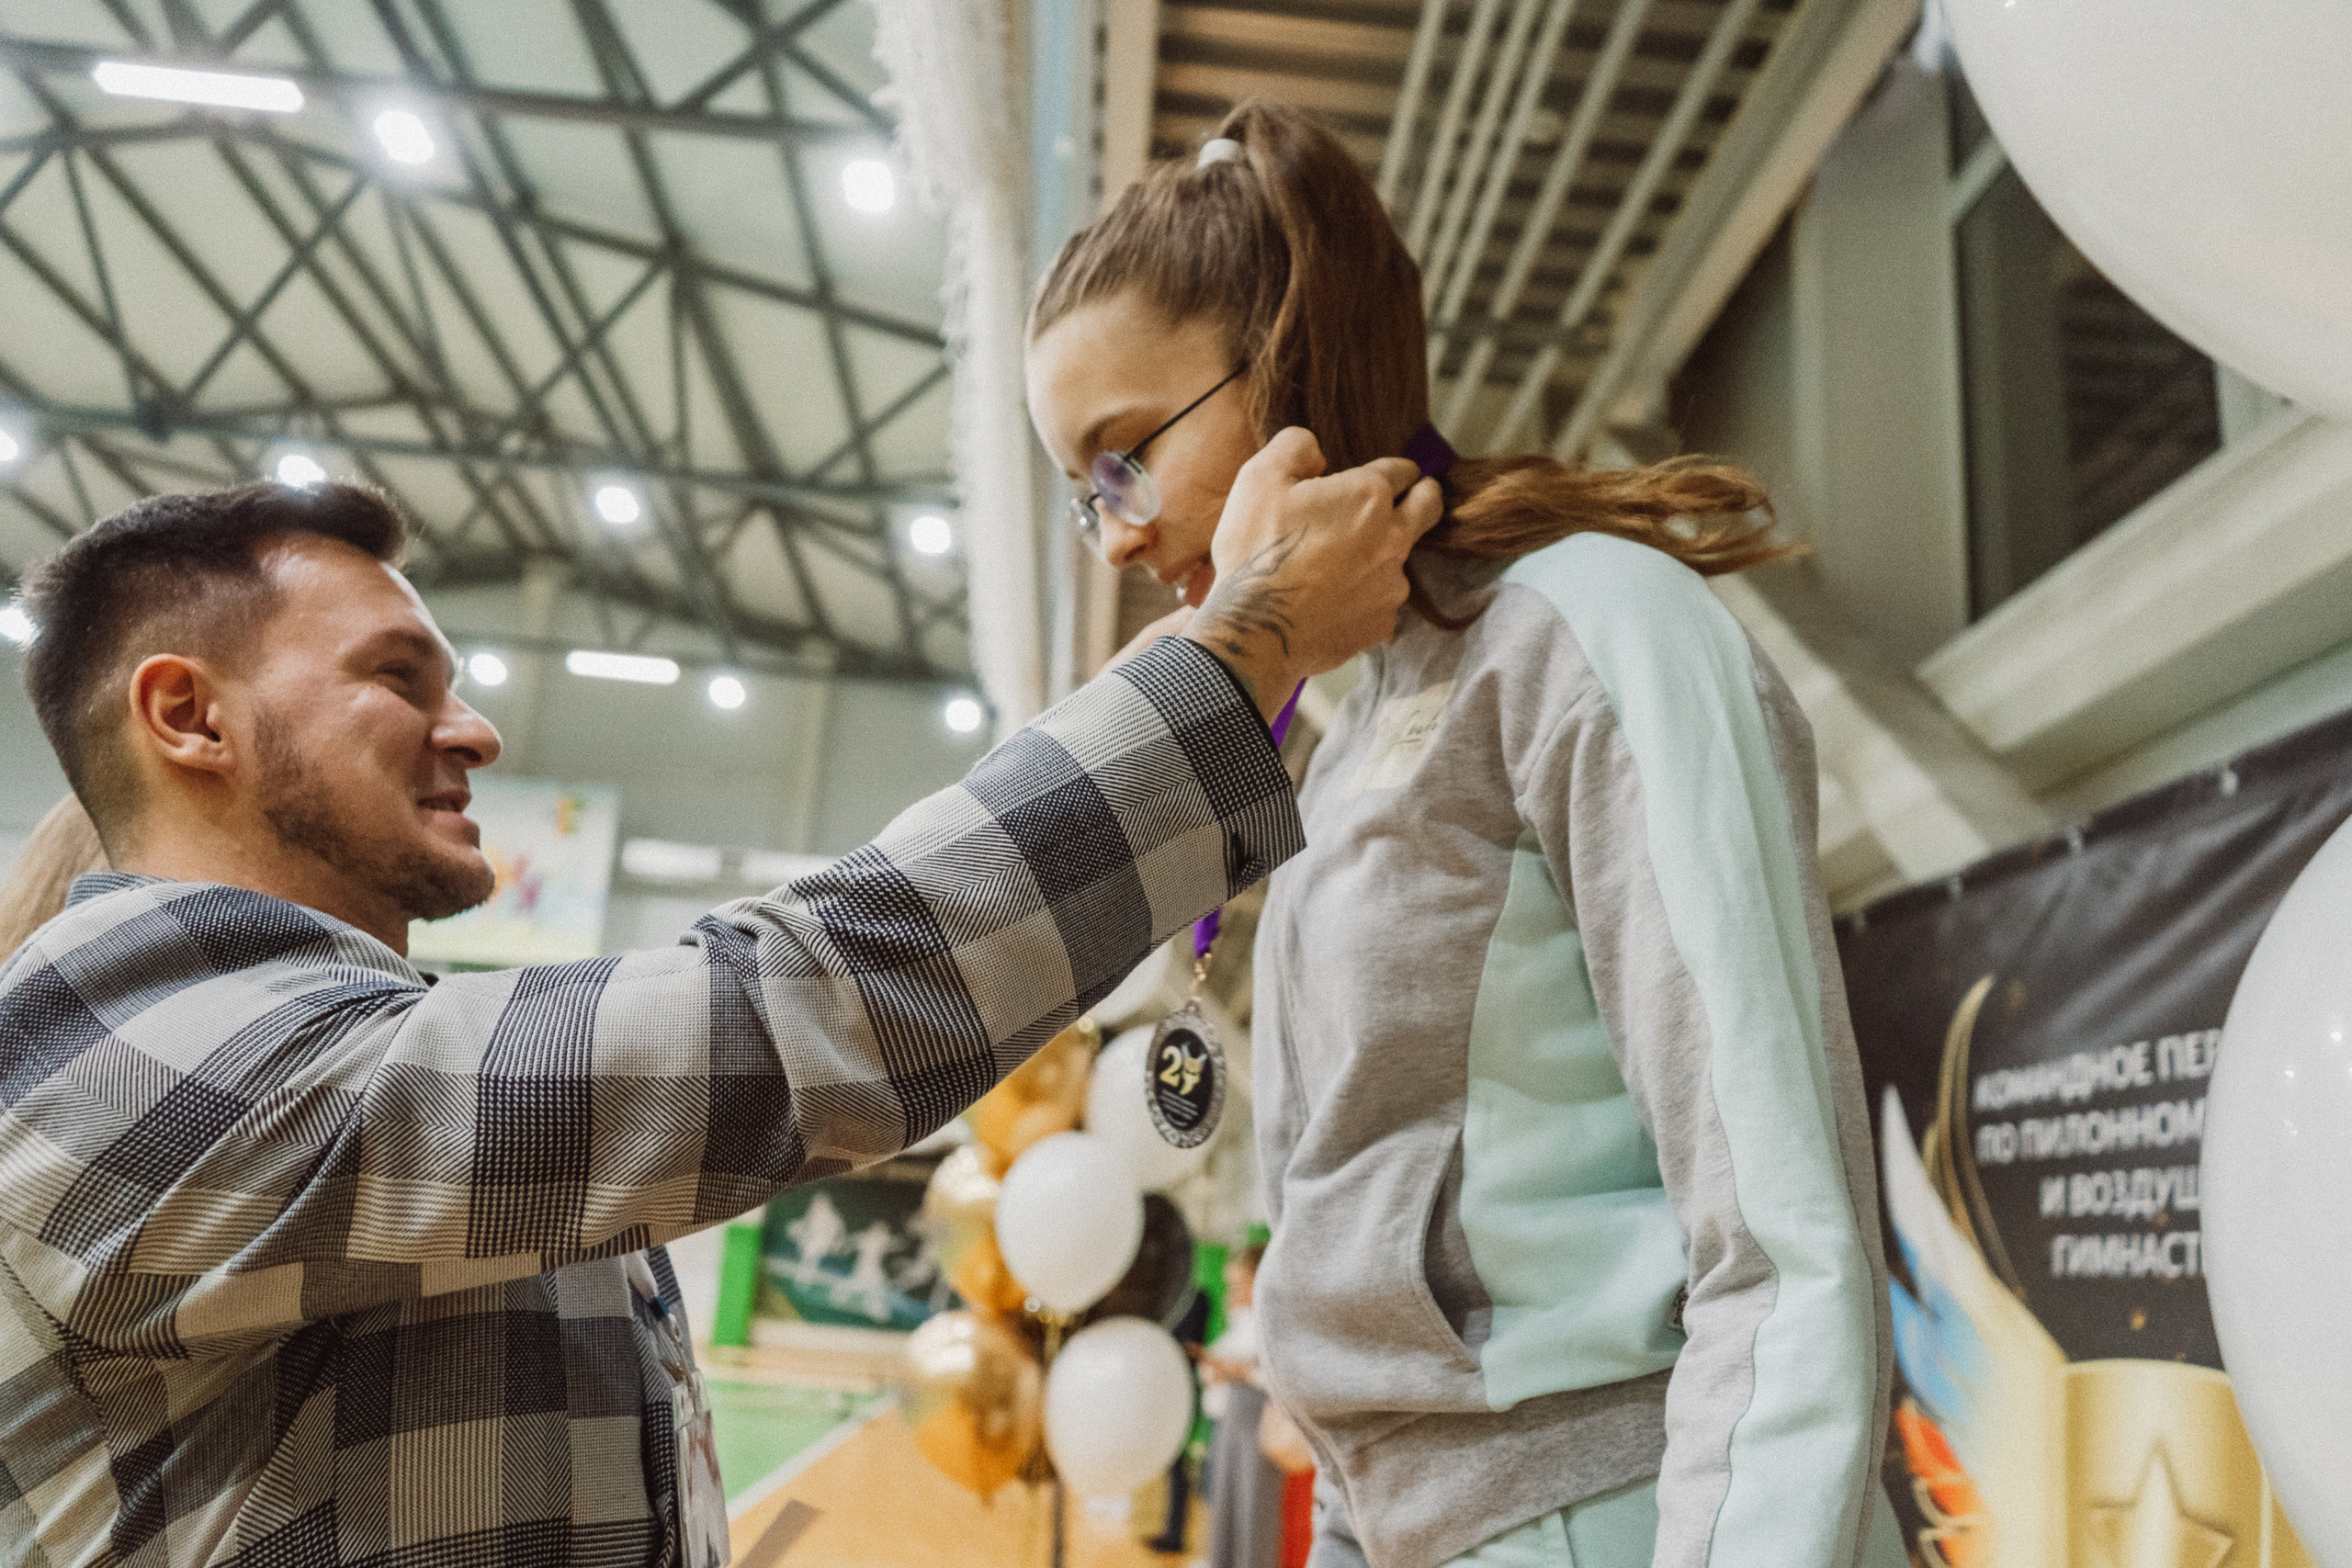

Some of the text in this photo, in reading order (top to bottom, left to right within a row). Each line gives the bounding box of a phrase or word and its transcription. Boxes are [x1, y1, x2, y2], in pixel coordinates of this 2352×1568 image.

[1975, 1040, 2153, 1109] КОМАНДНОЕ
[1977, 1122, 2018, 1164] ПО
[2040, 1176, 2065, 1218] И
